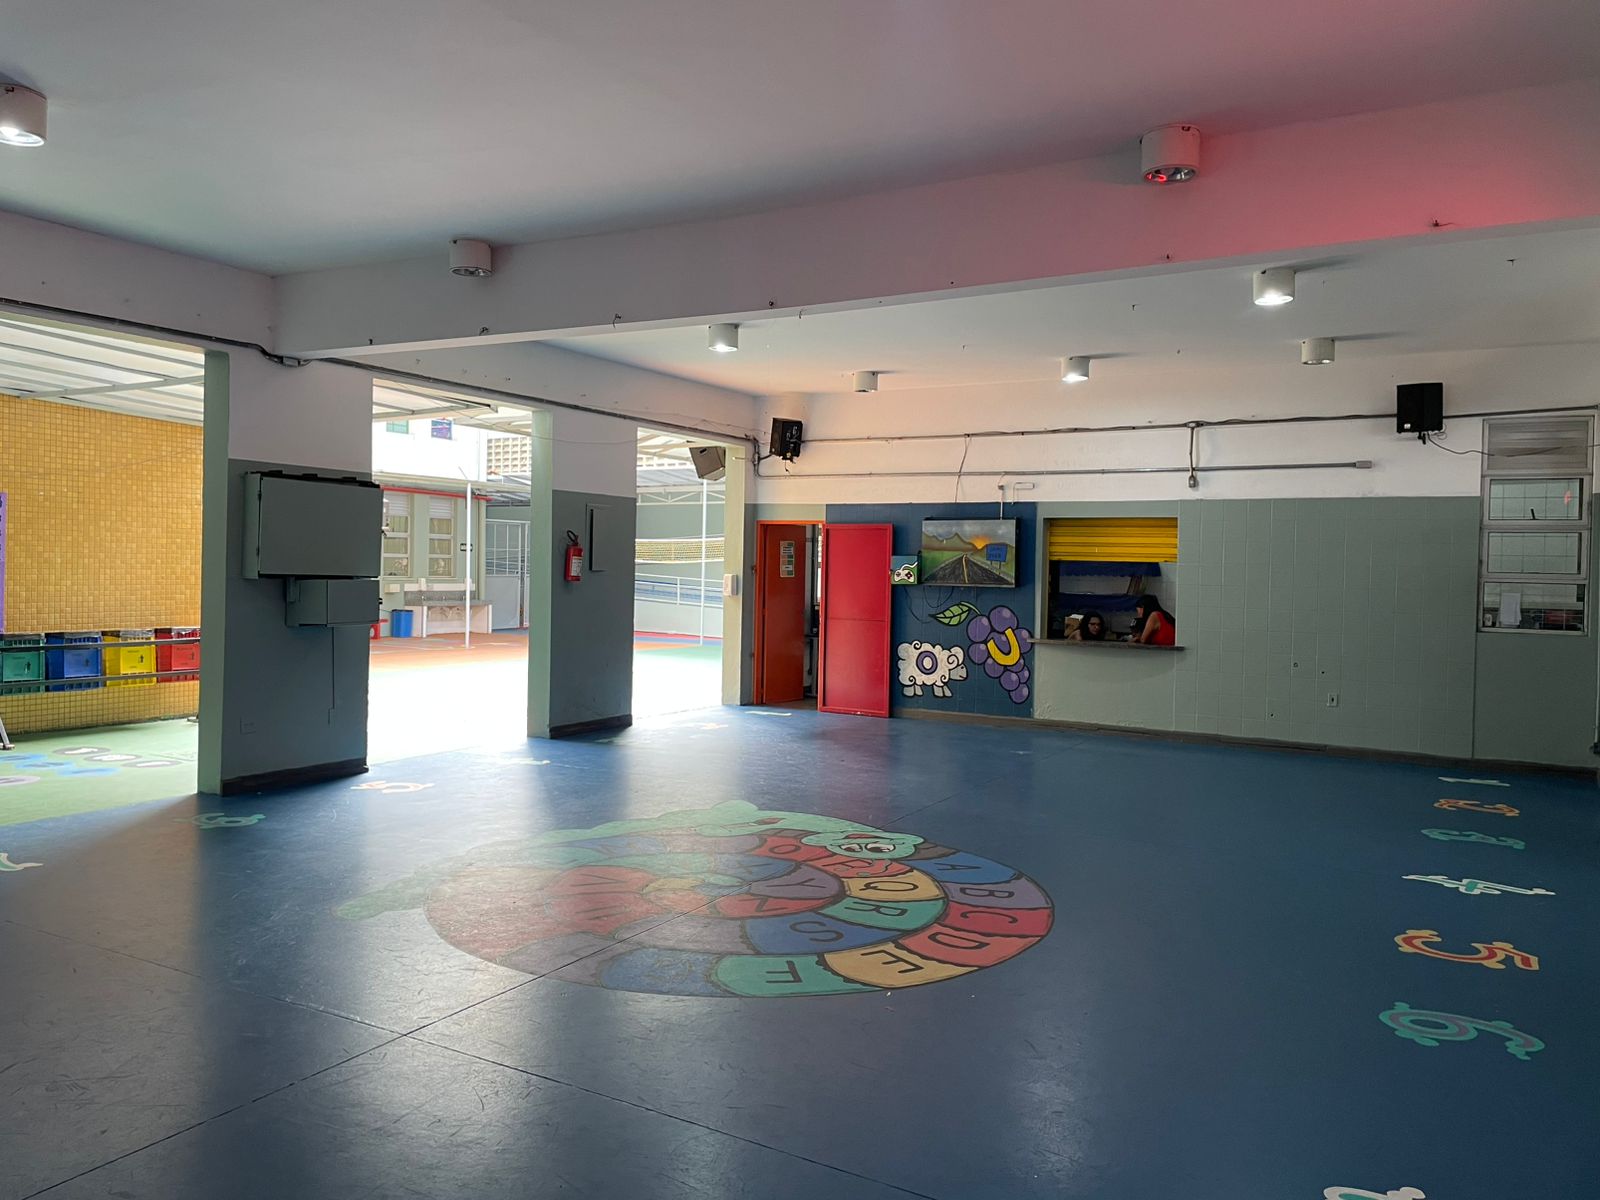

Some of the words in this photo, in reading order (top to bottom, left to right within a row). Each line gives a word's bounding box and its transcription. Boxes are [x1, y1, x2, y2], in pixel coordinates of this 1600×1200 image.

[987, 628, 1020, 666] U
[916, 651, 938, 675] O
[937, 862, 982, 872] A
[766, 878, 826, 890] Y
[859, 881, 918, 893] Q
[959, 887, 1015, 899] B
[844, 901, 908, 918] R
[961, 910, 1019, 924] C
[789, 921, 845, 943] S
[927, 931, 990, 950] D
[1394, 929, 1540, 971] 5
[764, 960, 803, 984] F
[860, 949, 924, 975] E
[1379, 1001, 1545, 1060] 6
